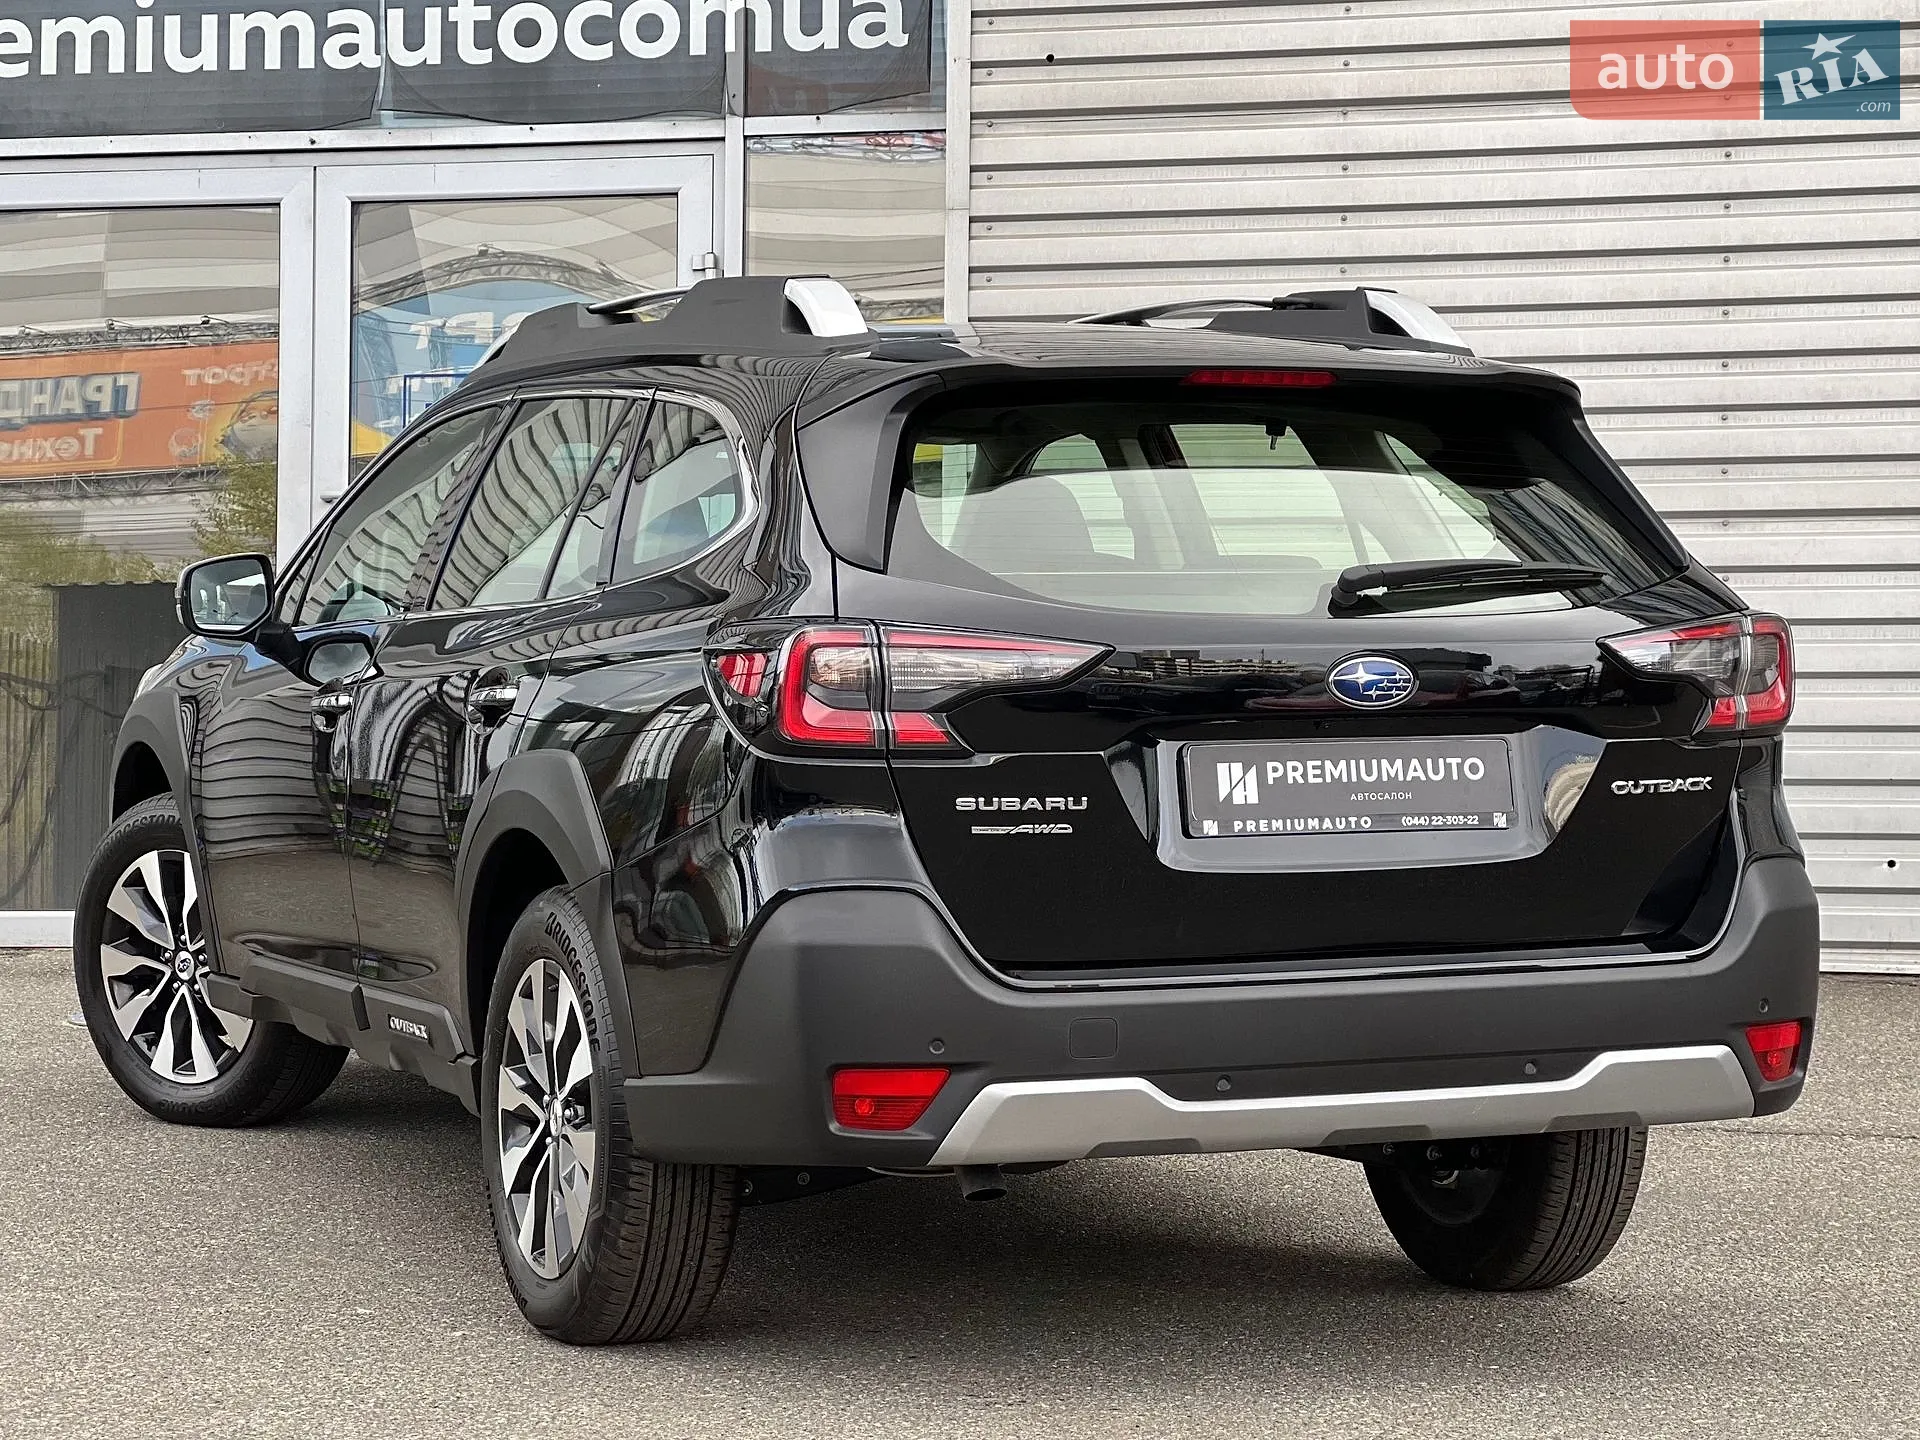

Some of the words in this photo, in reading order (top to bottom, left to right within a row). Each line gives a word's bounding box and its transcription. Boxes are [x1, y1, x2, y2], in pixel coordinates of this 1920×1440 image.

[1266, 757, 1485, 785] PREMIUMAUTO
[1610, 776, 1713, 795] OUTBACK
[955, 796, 1088, 811] SUBARU
[1350, 792, 1412, 801] АВТОСАЛОН
[1233, 816, 1372, 832] PREMIUMAUTO
[1401, 815, 1430, 827] (044)
[1431, 814, 1479, 827] 22-303-22
[389, 1016, 428, 1039] OUTBACK
